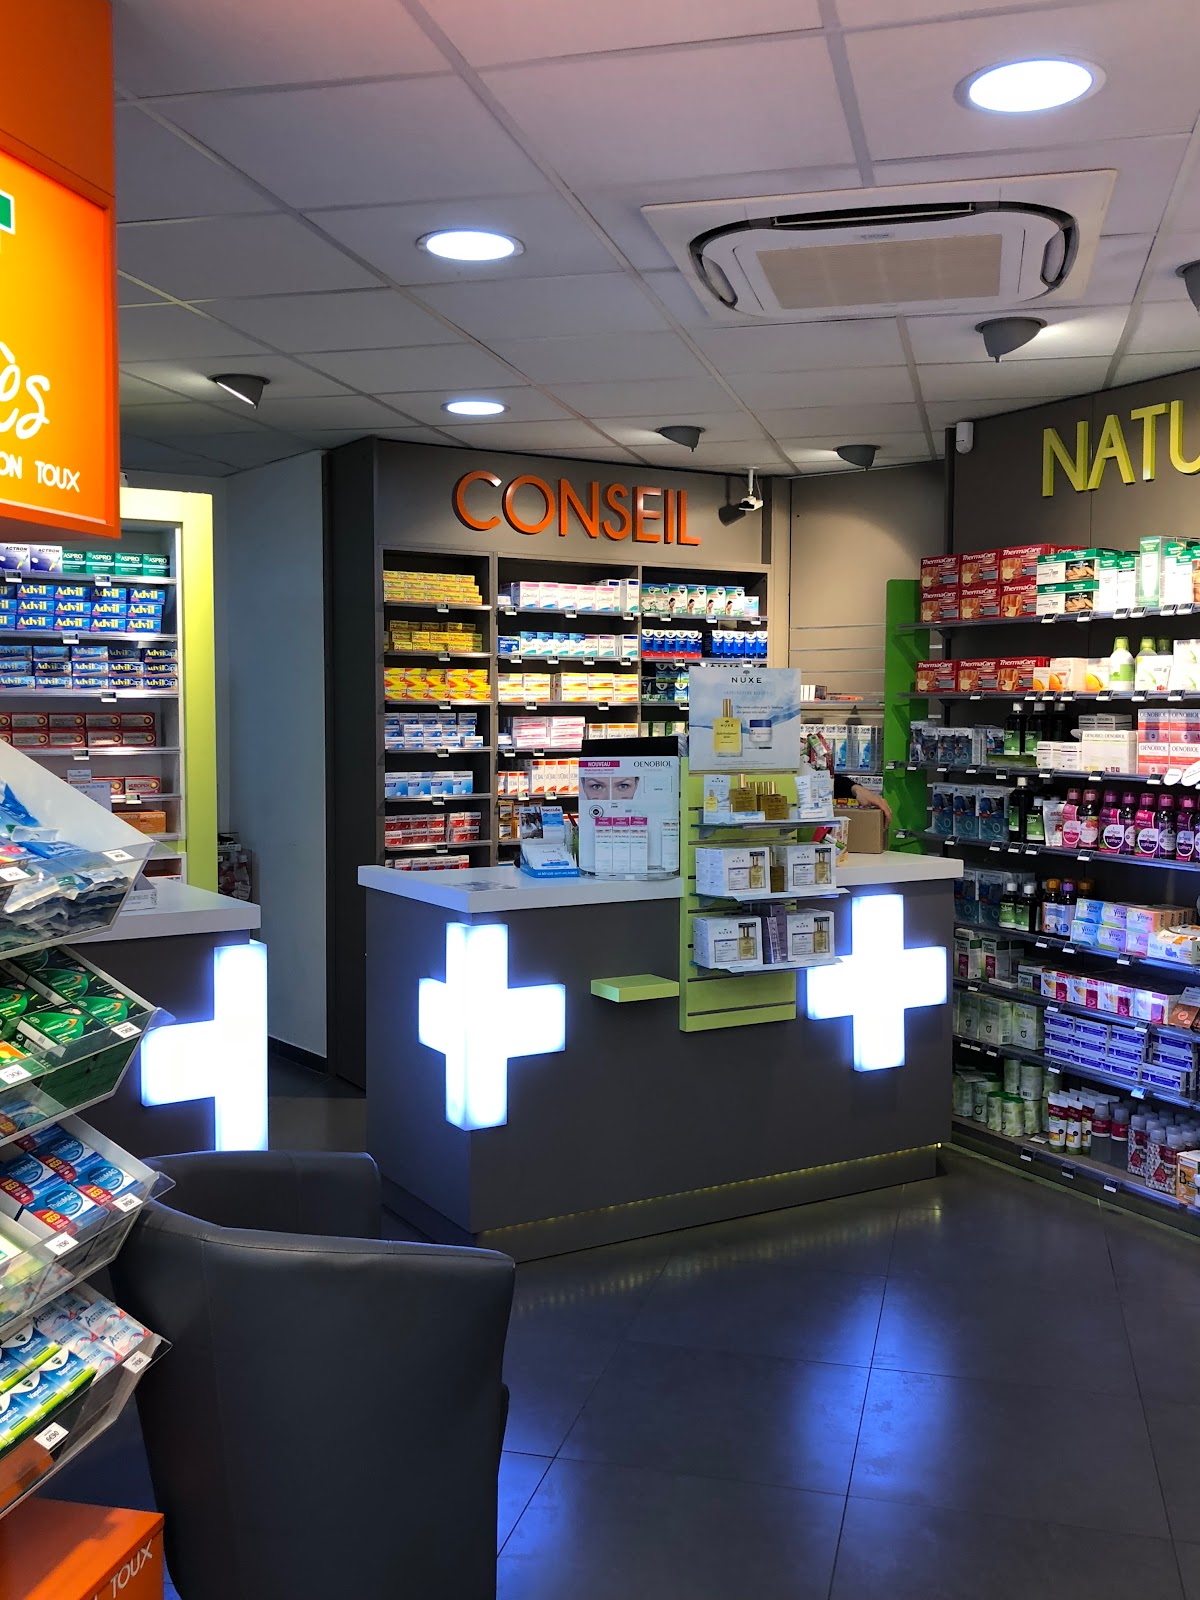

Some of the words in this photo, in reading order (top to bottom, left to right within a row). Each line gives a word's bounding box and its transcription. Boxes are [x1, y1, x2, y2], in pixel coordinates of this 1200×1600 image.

[35, 461, 80, 493] TOUX
[455, 470, 702, 546] CONSEIL
[962, 552, 996, 561] ThermaCare
[1003, 547, 1041, 556] ThermaCare
[91, 553, 112, 561] ASPRO
[922, 557, 957, 566] ThermaCare
[19, 585, 47, 595] Advil
[55, 586, 84, 597] Advil
[93, 588, 119, 598] Advil
[132, 589, 158, 599] Advil
[962, 588, 997, 596] ThermaCare
[922, 592, 957, 600] ThermaCare
[19, 600, 47, 611] Advil
[56, 601, 84, 612] Advil
[93, 602, 120, 613] Advil
[129, 604, 155, 614] Advil
[19, 616, 46, 626] Advil
[55, 617, 83, 627] Advil
[92, 618, 119, 628] Advil
[128, 619, 154, 629] Advil
[960, 660, 996, 668] ThermaCare
[1140, 744, 1168, 752] OENOBIOL
[633, 760, 672, 768] OENOBIOL
[32, 1304, 57, 1328] ACTIVIR
[84, 1304, 108, 1327] ACTIVIR
[109, 1325, 131, 1347] ACTIVIR
[19, 1337, 42, 1353] VapoRub
[84, 1349, 101, 1365] CTIVIR
[56, 1360, 78, 1377] VapoRub
[27, 1383, 49, 1399] VapoRub
[110, 1539, 153, 1599] TOUX
